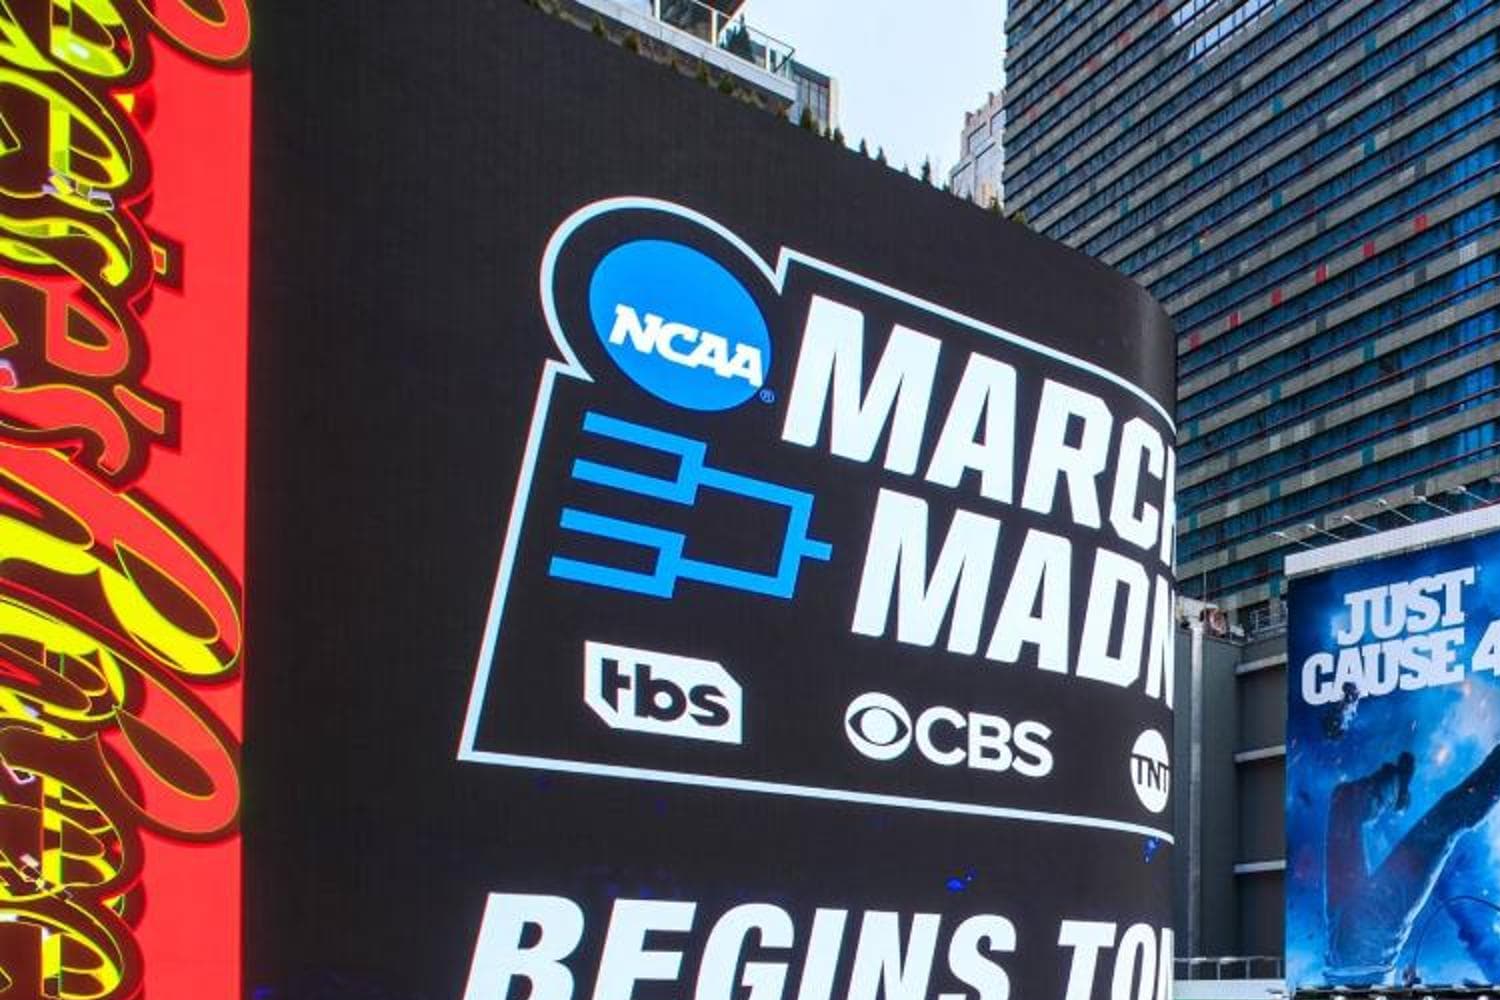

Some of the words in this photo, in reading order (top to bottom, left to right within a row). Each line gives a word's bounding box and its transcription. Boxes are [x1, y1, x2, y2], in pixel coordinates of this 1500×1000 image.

[608, 303, 763, 388] NCAA
[1337, 565, 1475, 646] JUST
[602, 658, 730, 728] tbs
[1301, 627, 1465, 706] CAUSE
[915, 706, 1053, 778] CBS
[1134, 754, 1170, 790] TNT
